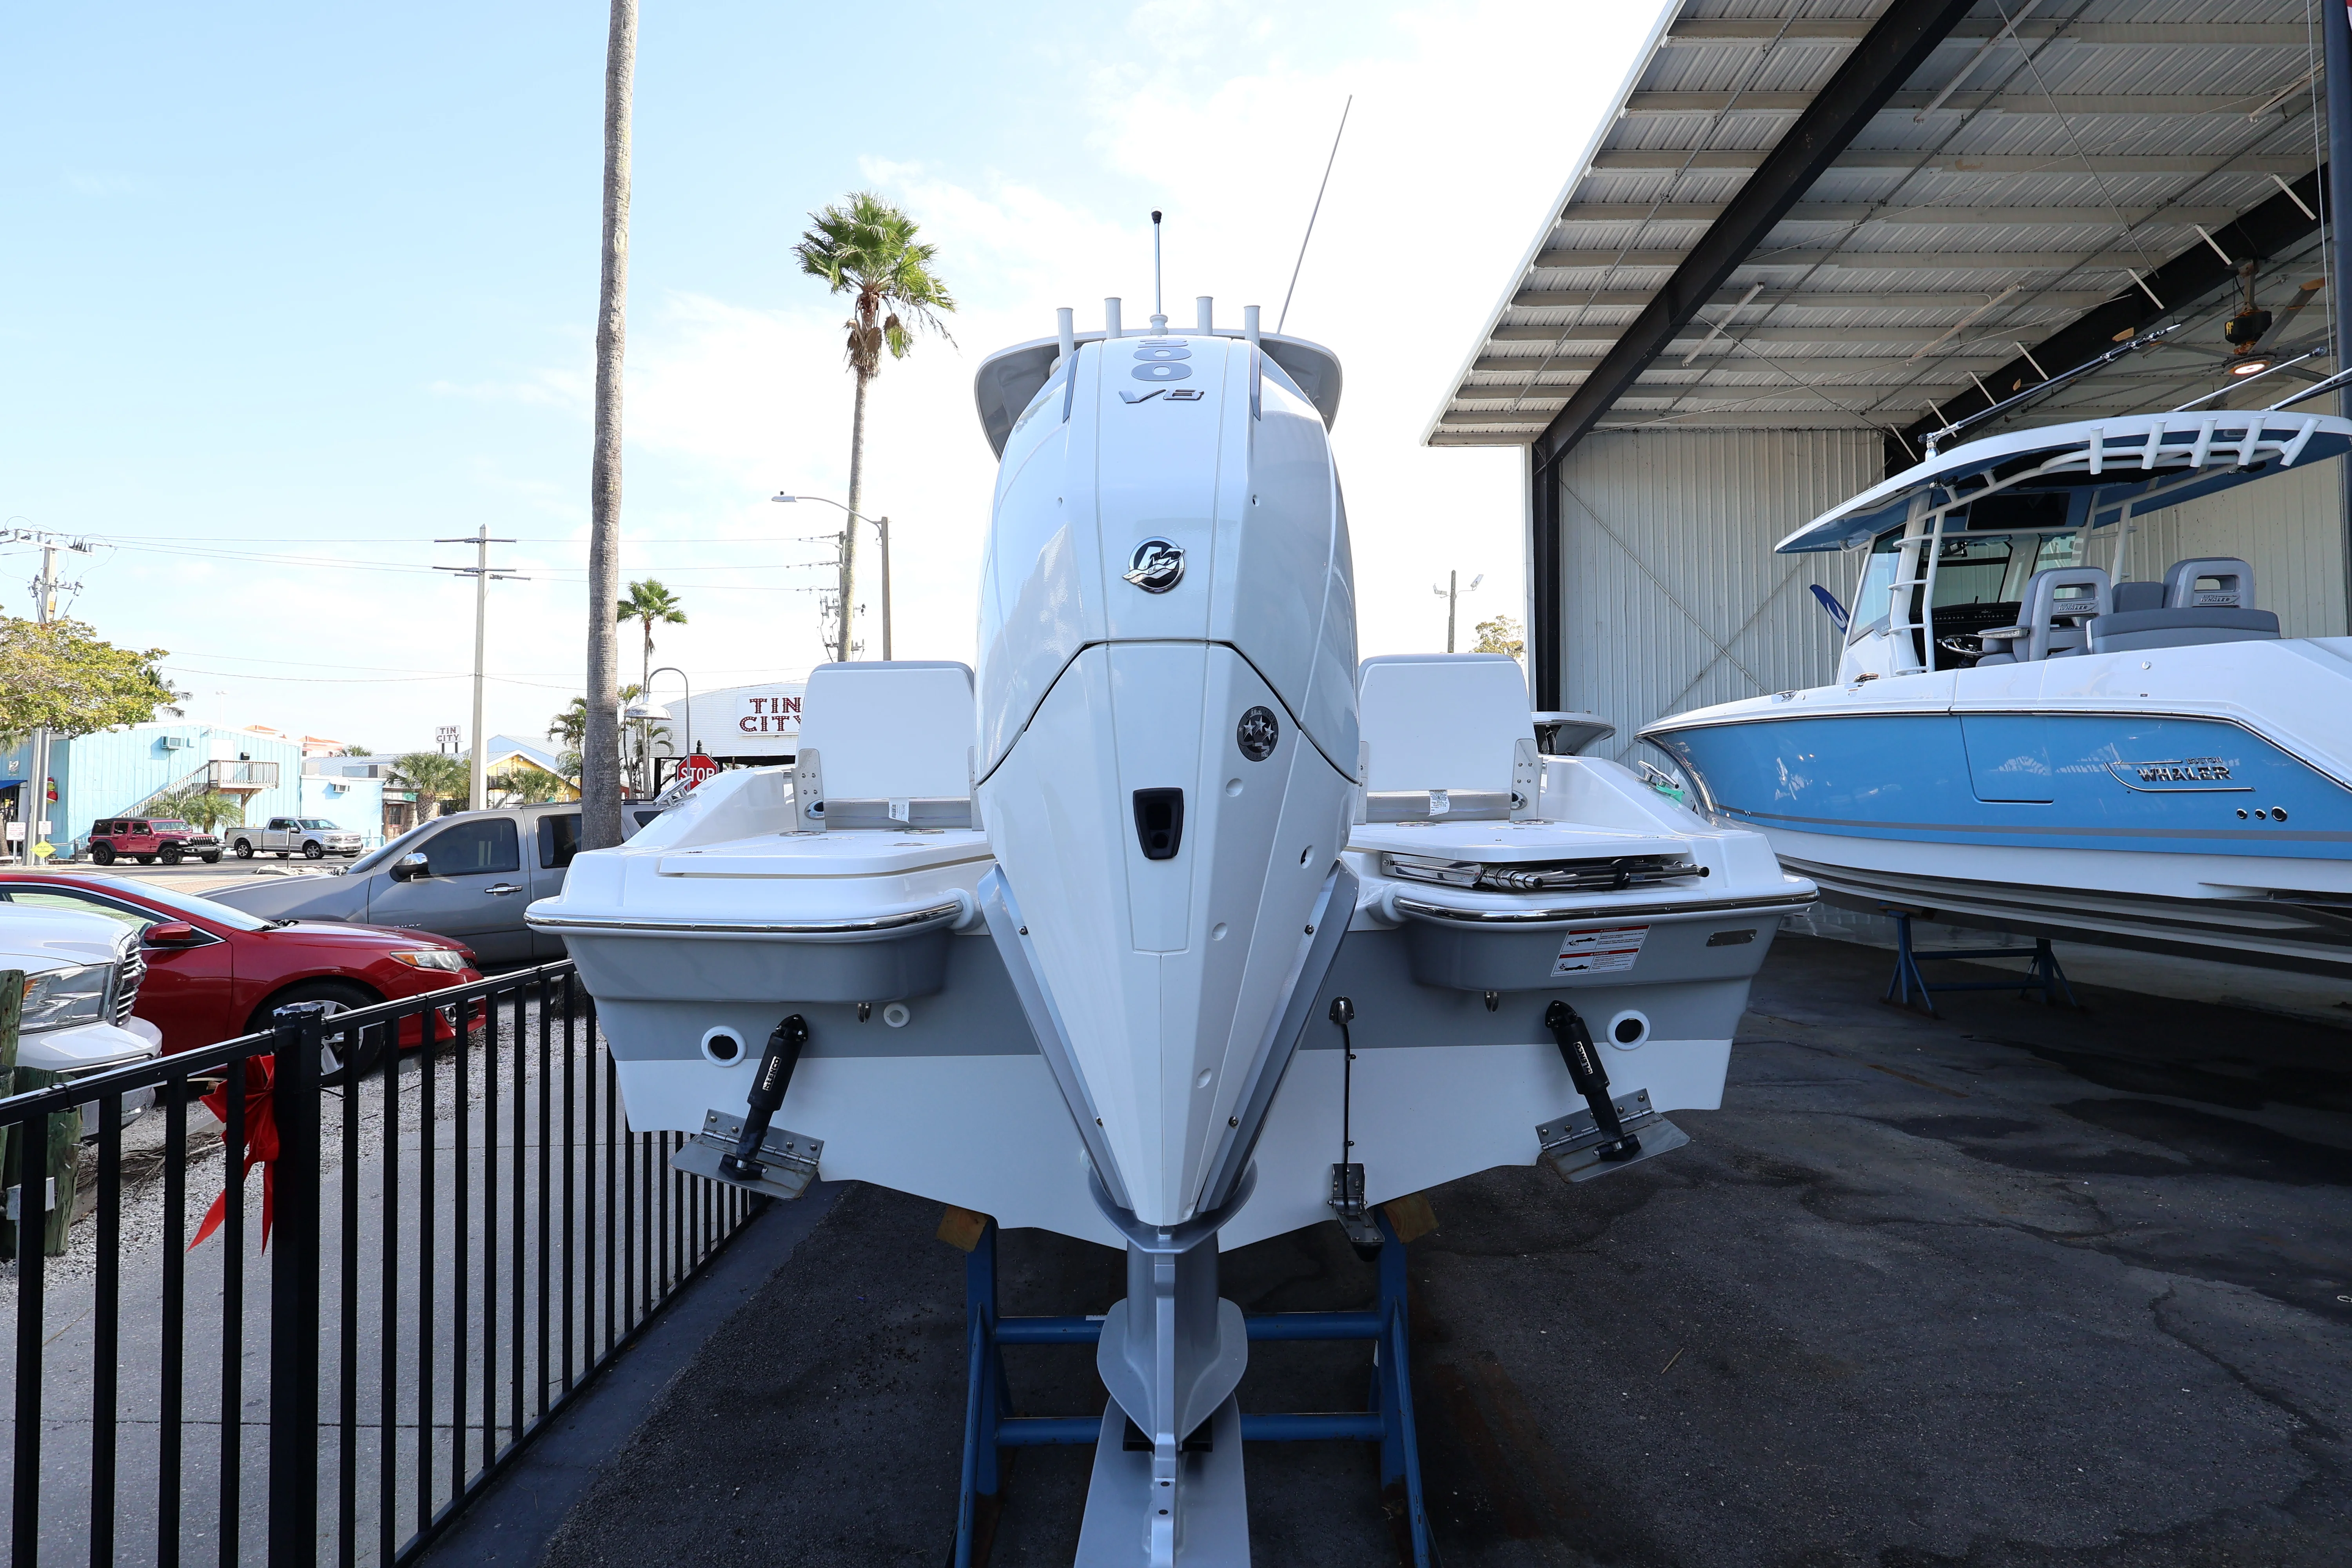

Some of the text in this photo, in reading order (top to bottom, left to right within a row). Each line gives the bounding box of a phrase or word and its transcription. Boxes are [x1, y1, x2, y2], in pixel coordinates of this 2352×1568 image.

[1118, 389, 1205, 404] V8
[749, 697, 801, 713] TIN
[1245, 708, 1277, 726] ULTRA LOW
[2185, 756, 2223, 765] BOSTON
[681, 767, 715, 782] STOP
[2136, 765, 2234, 782] WHALER
[1575, 1043, 1589, 1067] LENCO
